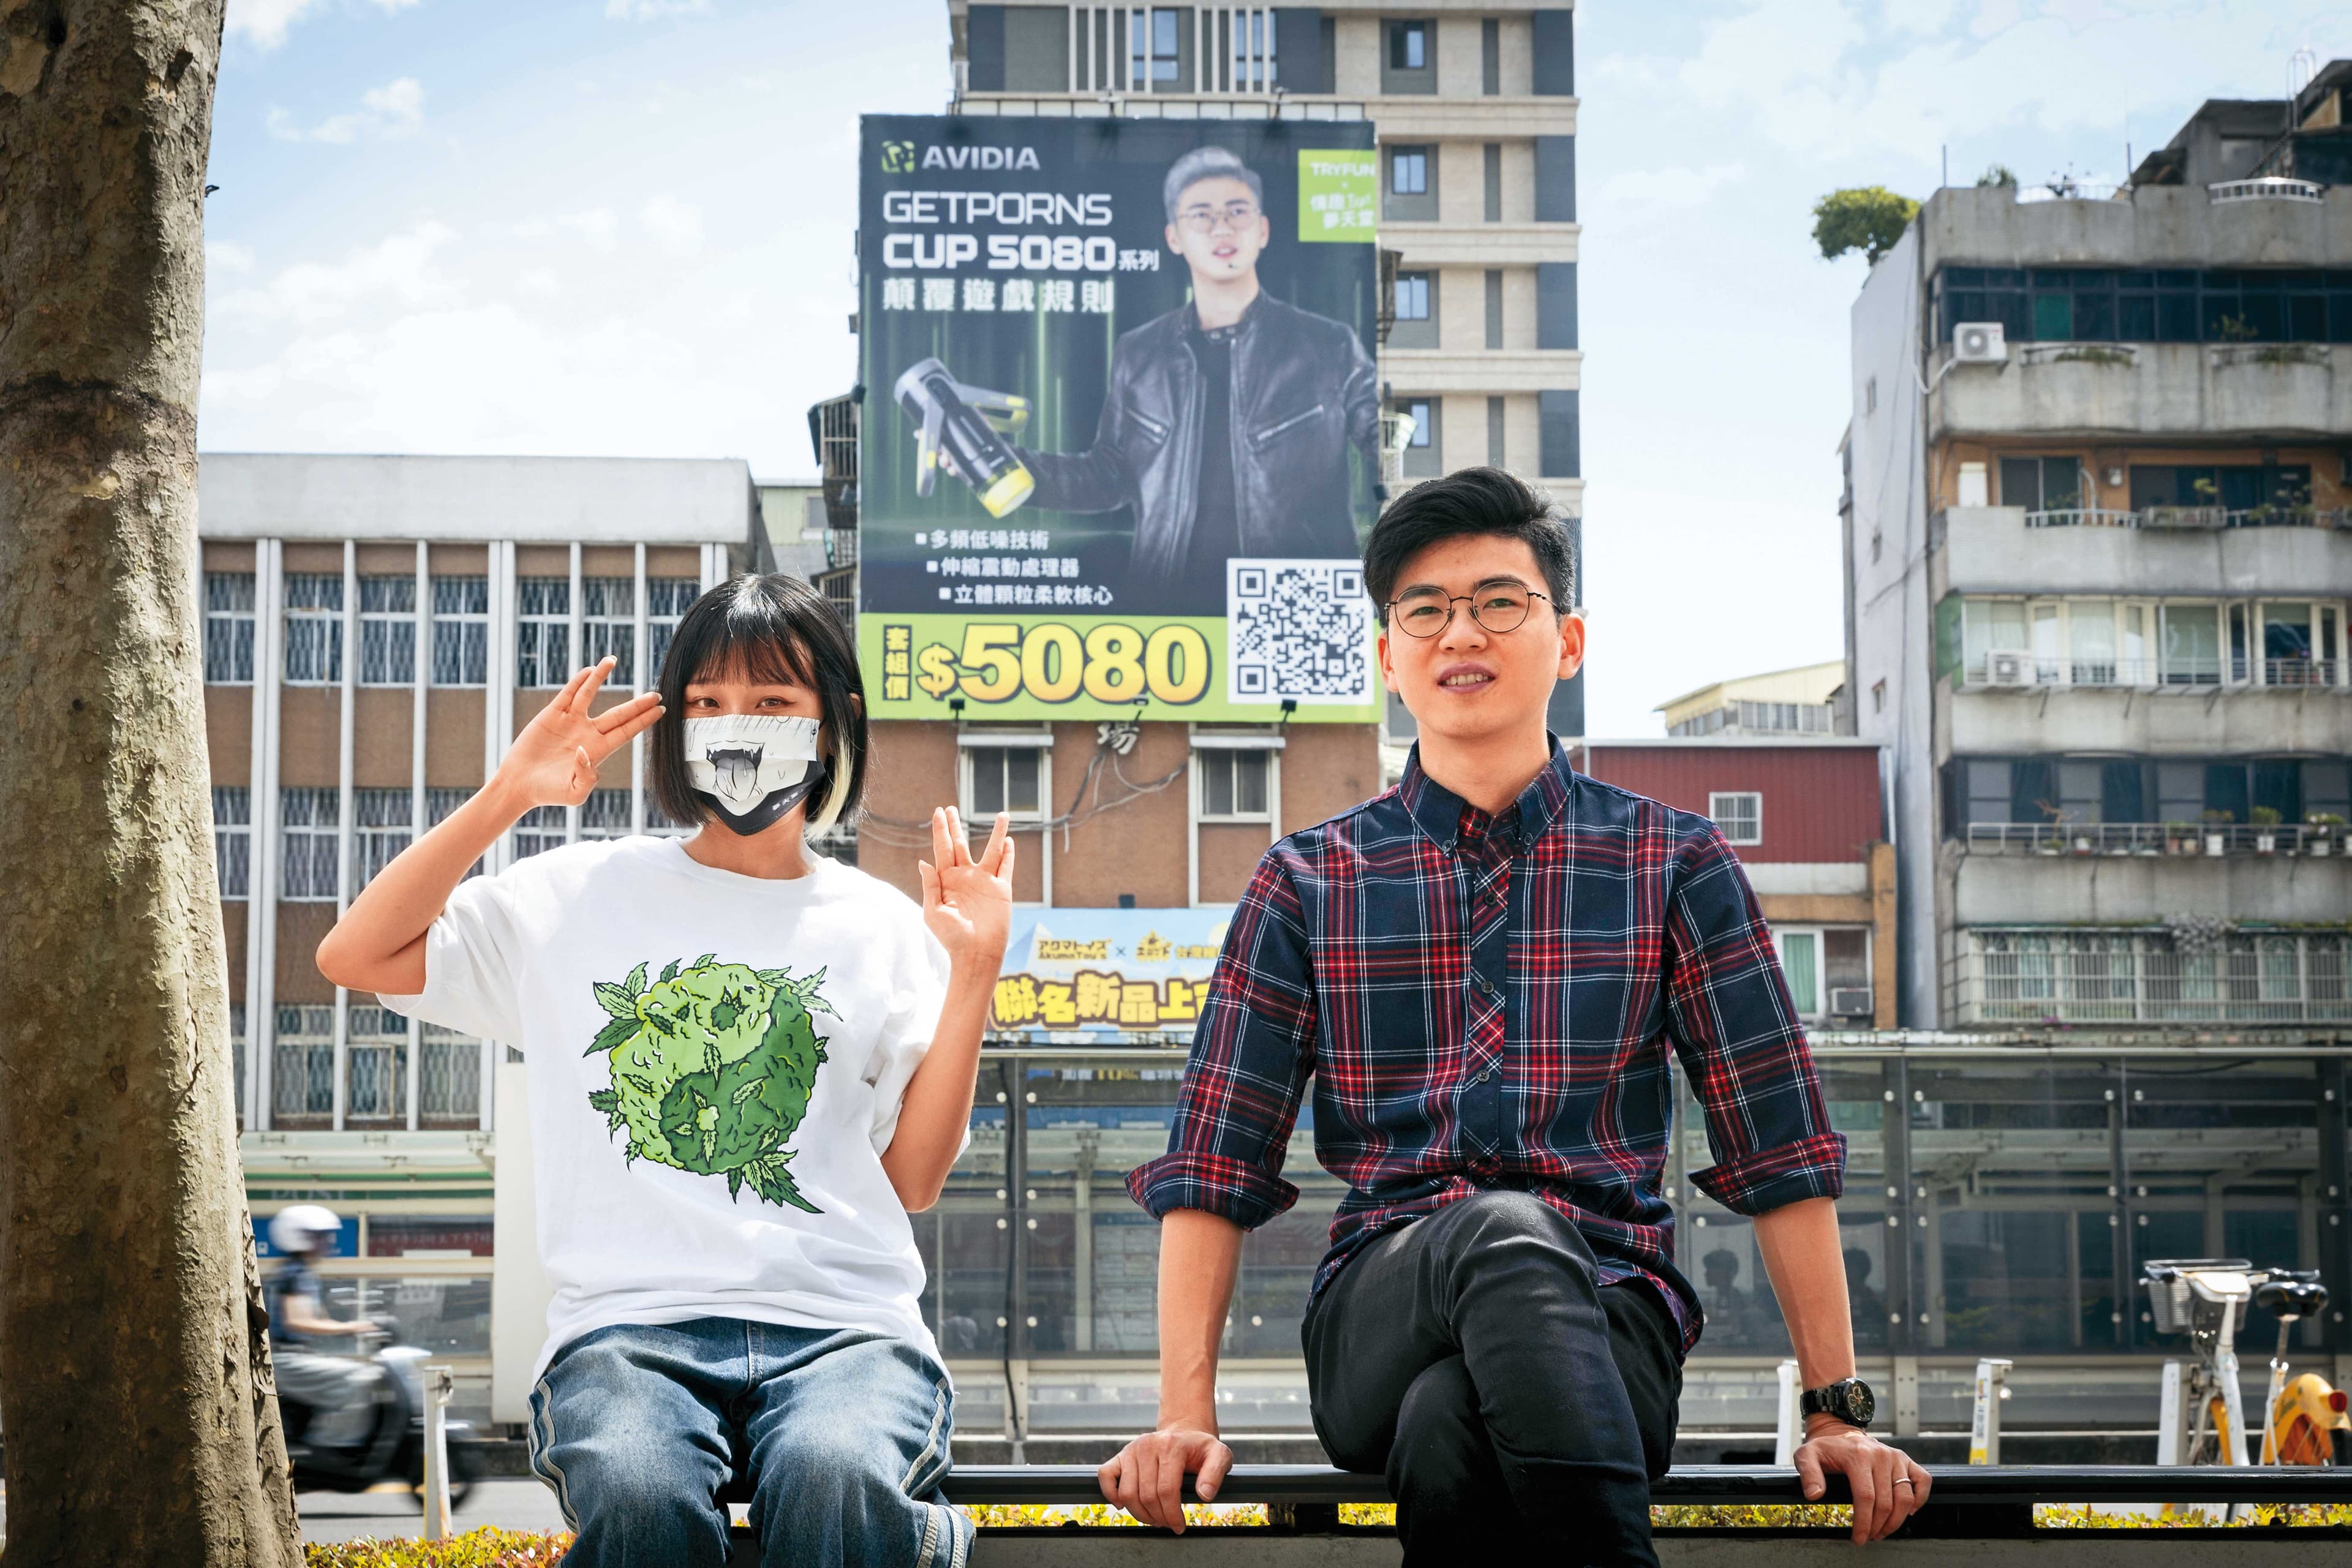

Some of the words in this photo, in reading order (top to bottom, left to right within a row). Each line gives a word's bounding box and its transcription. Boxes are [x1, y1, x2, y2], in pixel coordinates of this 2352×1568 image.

[922, 145, 1040, 170] AVIDIA
[1311, 162, 1376, 177] TRYFUN
[883, 190, 1113, 227] GETPORNS
[883, 233, 979, 270] CUP
[987, 234, 1116, 272] 5080
[882, 277, 1115, 314] 顛覆遊戲規則
[930, 529, 1049, 550] 多頻低噪技術
[940, 557, 1080, 578] 伸縮震動處理器
[954, 584, 1114, 606] 立體顆粒柔軟核心
[916, 623, 1211, 706] $5080
